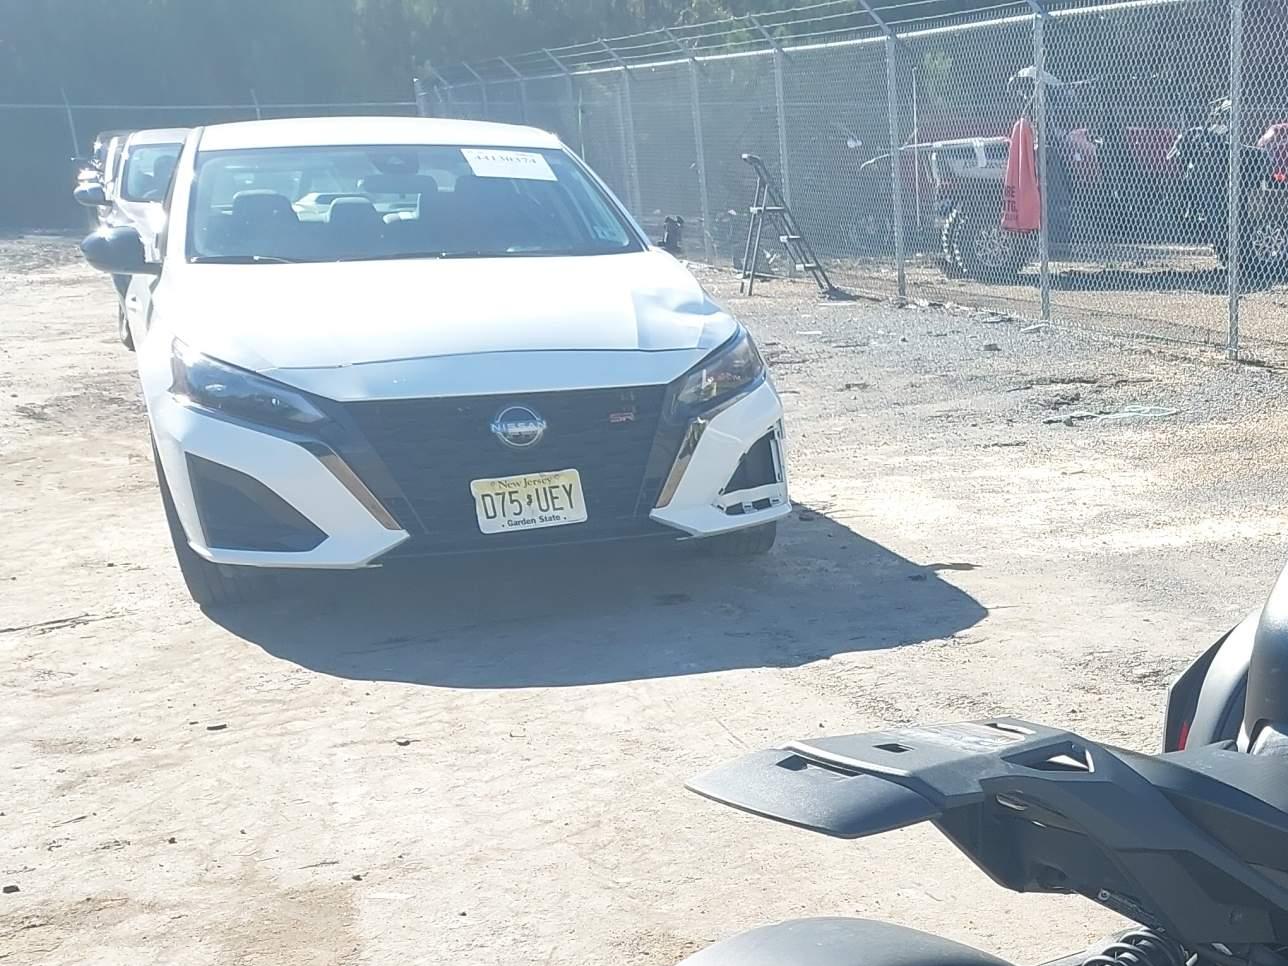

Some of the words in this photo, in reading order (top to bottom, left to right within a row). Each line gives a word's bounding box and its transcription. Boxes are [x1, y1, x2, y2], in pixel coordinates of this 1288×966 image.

[609, 411, 635, 423] SR
[490, 419, 547, 433] NISSAN
[498, 479, 522, 489] New
[523, 475, 553, 489] Jersey
[507, 516, 537, 528] Garden
[539, 514, 561, 524] State
